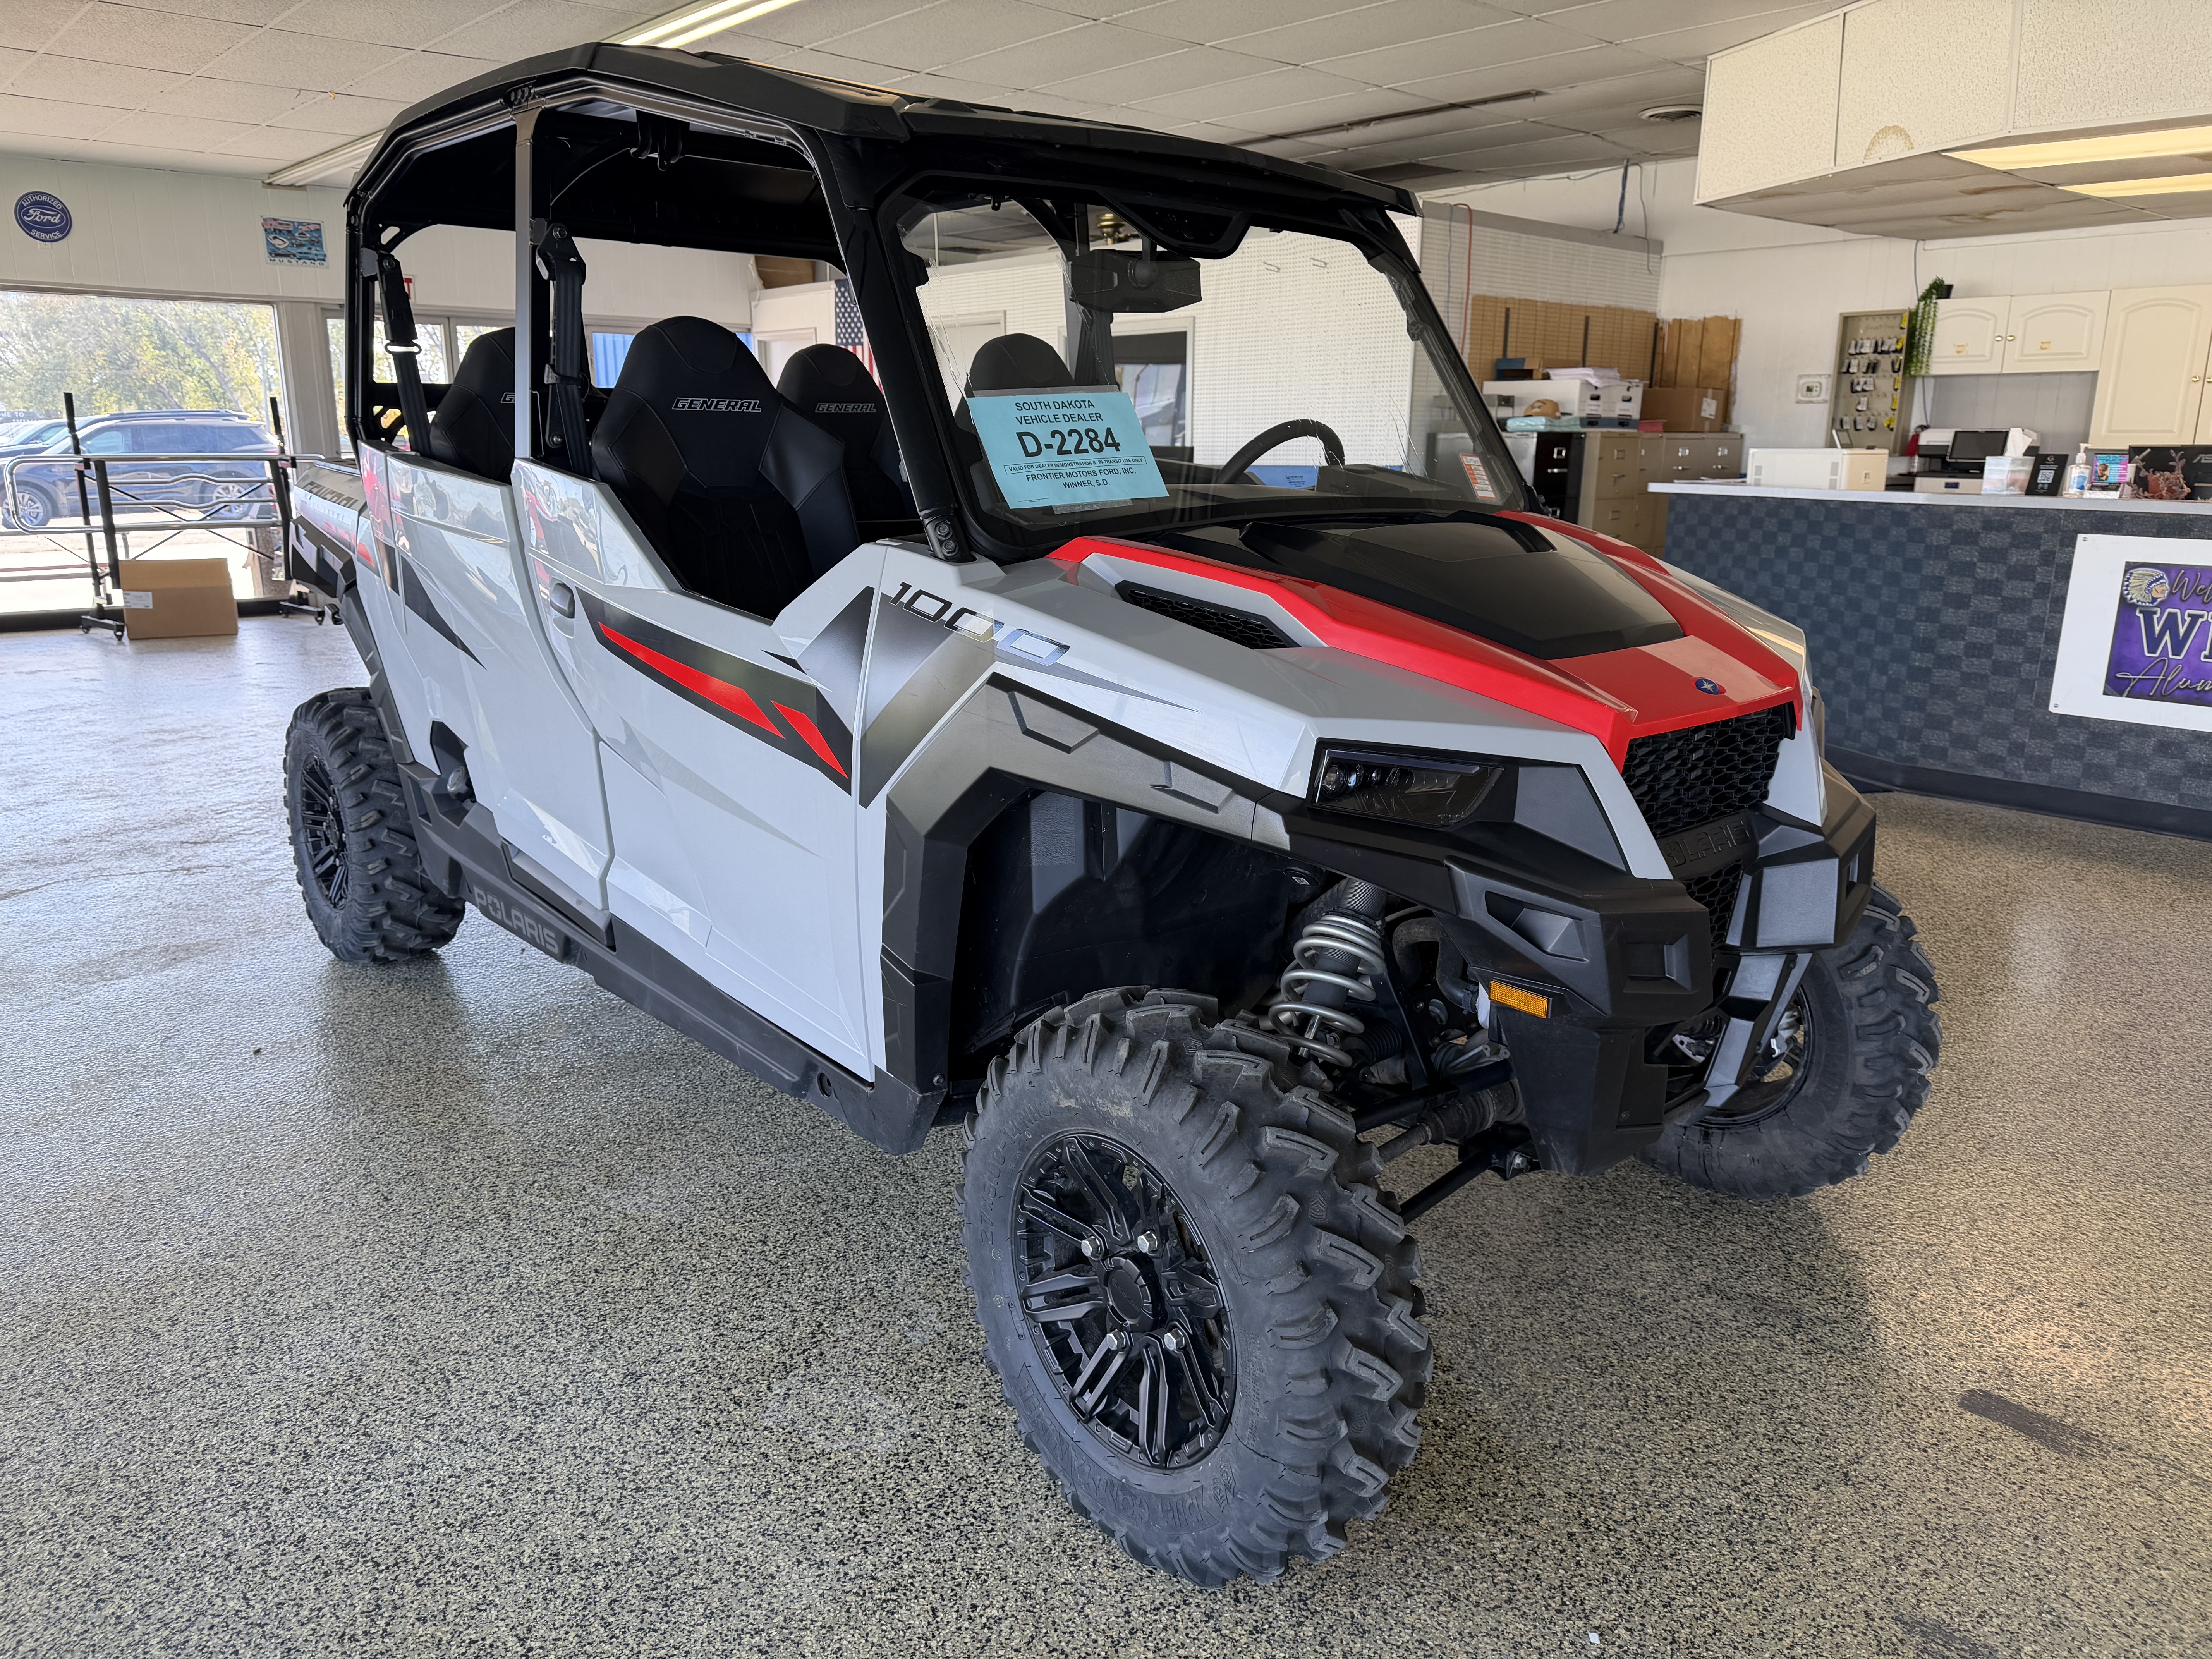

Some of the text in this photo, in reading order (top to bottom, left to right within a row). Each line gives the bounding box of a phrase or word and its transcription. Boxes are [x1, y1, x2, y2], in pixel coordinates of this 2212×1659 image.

[22, 195, 62, 210] AUTHORIZED
[24, 208, 61, 223] Ford
[31, 229, 61, 239] SERVICE
[269, 258, 325, 266] MUSTANG
[672, 397, 762, 412] GENERAL
[815, 403, 876, 413] GENERAL
[1015, 400, 1095, 411] SOUTH DAKOTA
[1015, 413, 1103, 425] VEHICLE DEALER
[1016, 427, 1121, 457] D-2284
[1025, 472, 1065, 481] FRONTIER
[1065, 470, 1098, 479] MOTORS
[1062, 481, 1095, 489] WINNER,
[889, 582, 1070, 666] 1000
[474, 883, 559, 954] POLARIS
